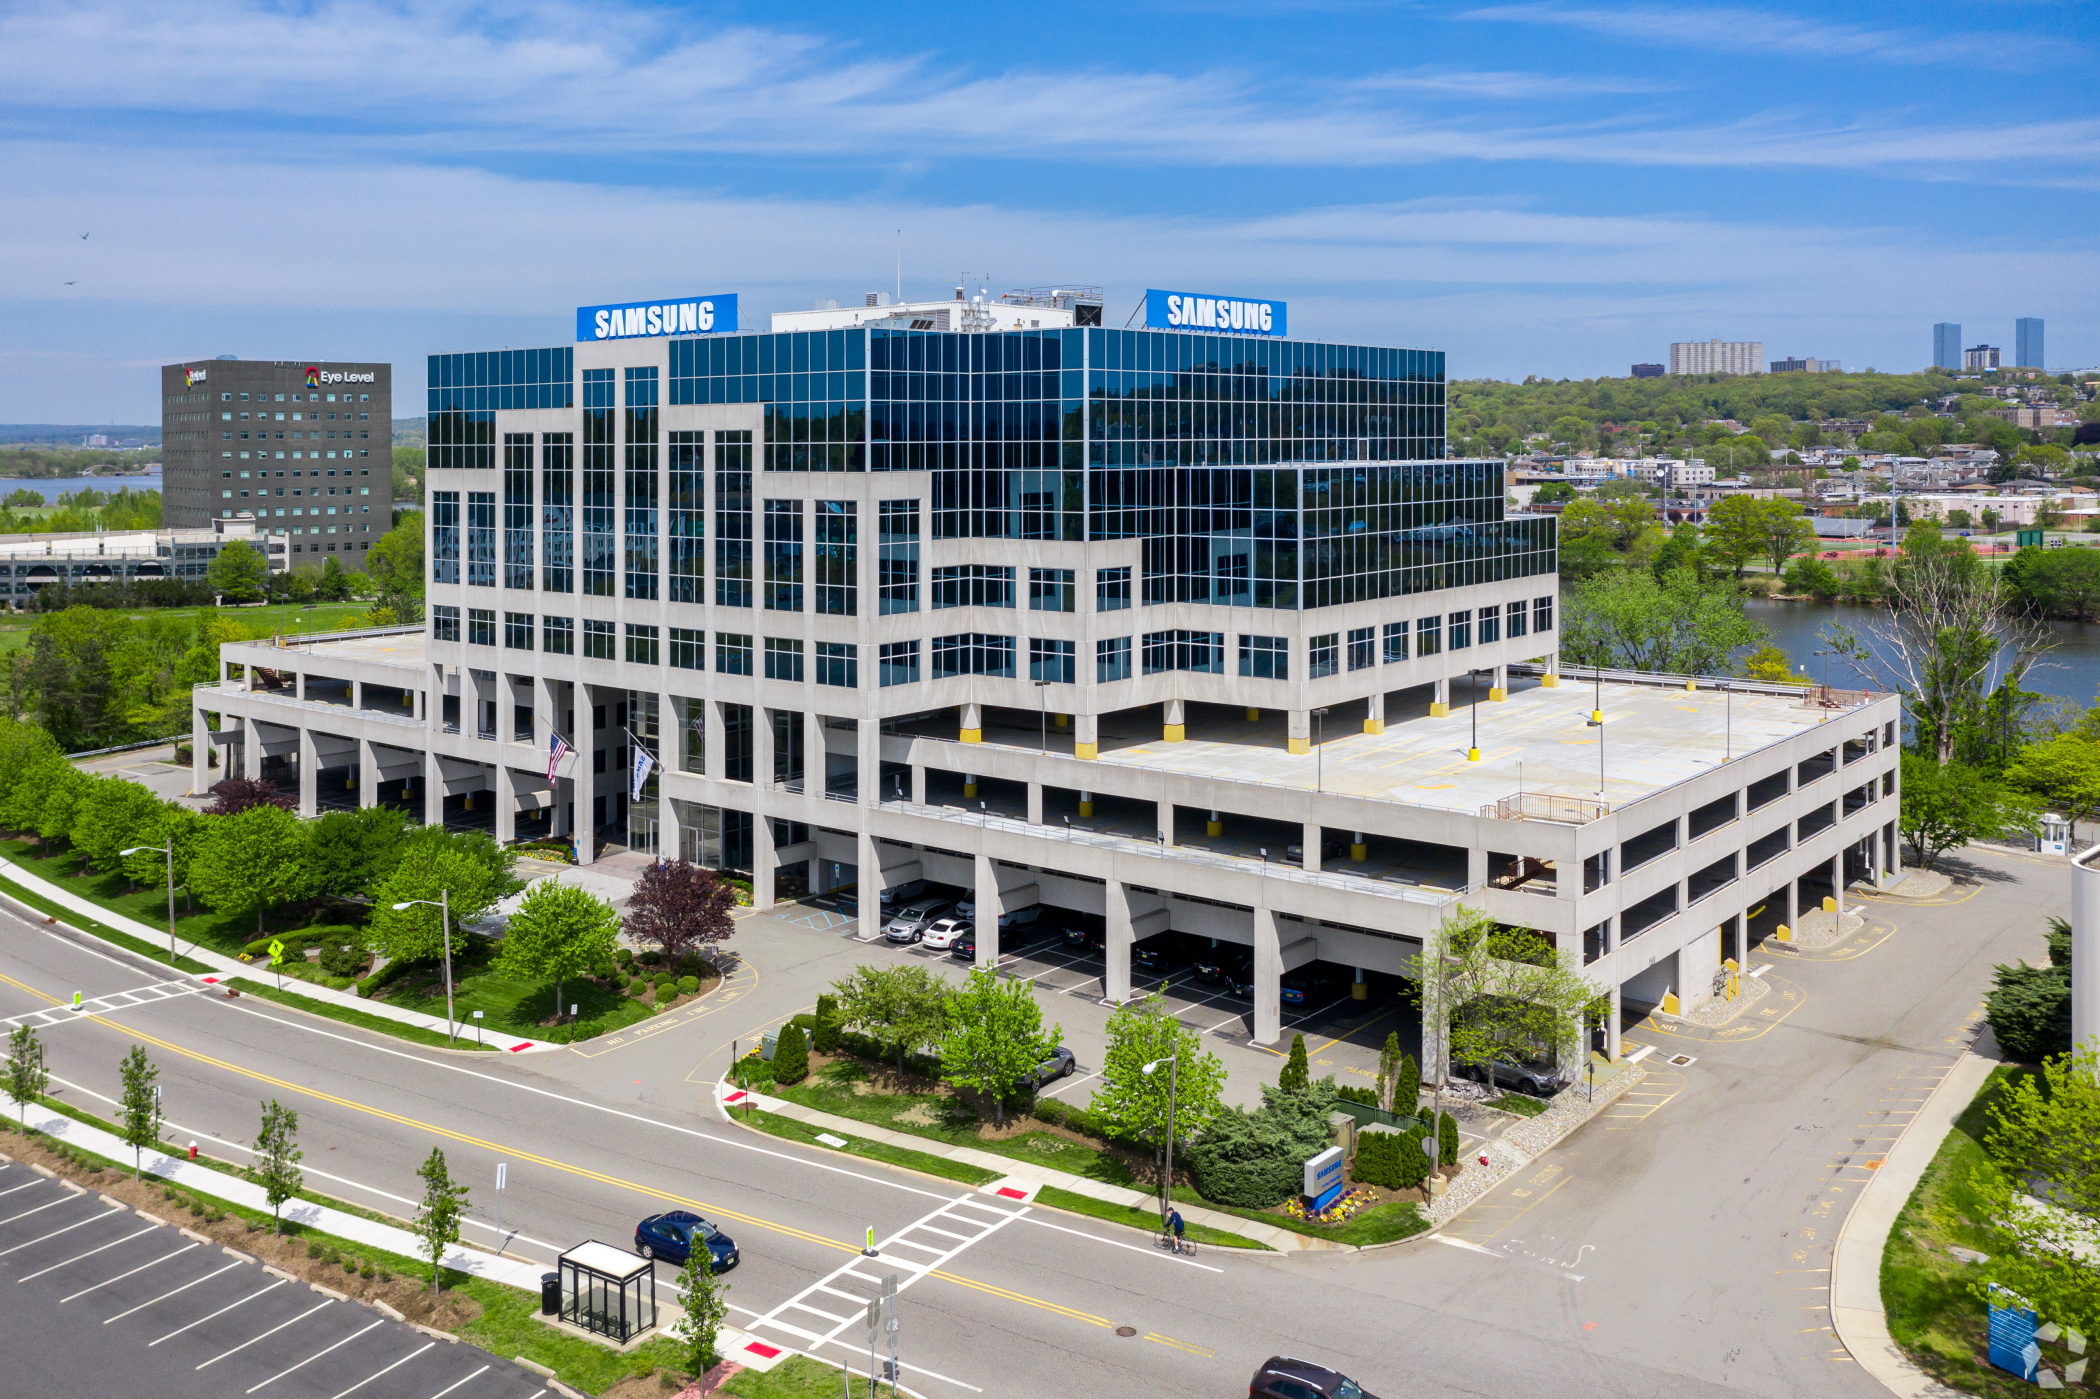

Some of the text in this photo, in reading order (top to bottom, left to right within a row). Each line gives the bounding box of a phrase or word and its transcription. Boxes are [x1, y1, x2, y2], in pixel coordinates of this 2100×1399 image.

[595, 301, 714, 338] SAMSUNG
[1167, 295, 1272, 331] SAMSUNG
[321, 371, 374, 384] Eye Level
[606, 1037, 624, 1045] NO
[634, 1018, 678, 1035] PARKING
[1660, 1023, 1678, 1032] NO
[1315, 1058, 1333, 1067] NO
